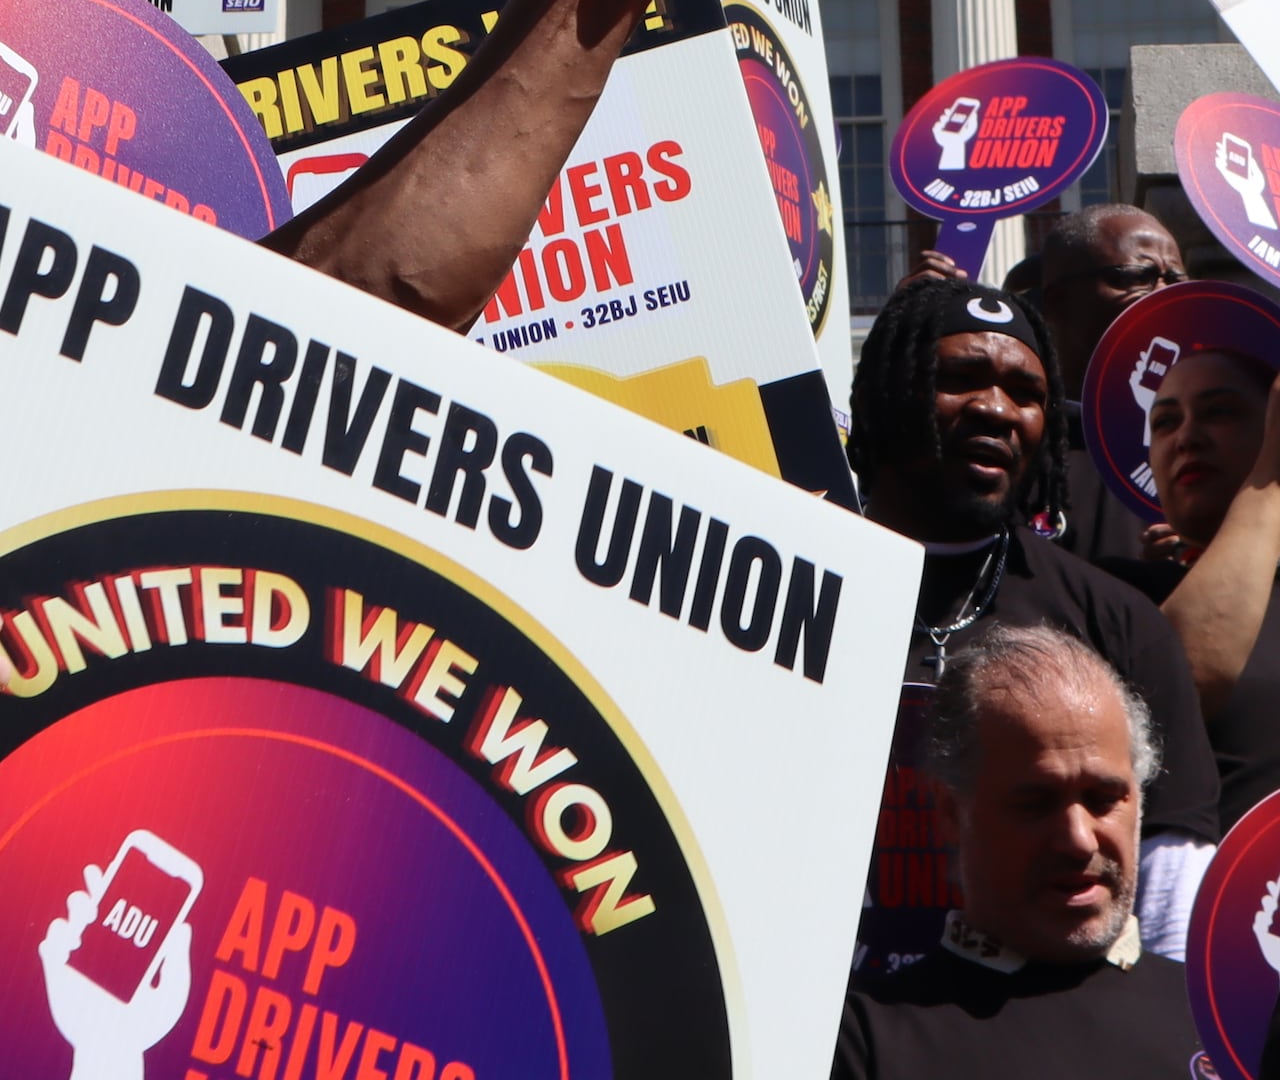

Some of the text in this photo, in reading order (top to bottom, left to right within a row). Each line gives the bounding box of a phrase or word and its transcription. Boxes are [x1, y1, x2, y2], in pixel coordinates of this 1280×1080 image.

[49, 75, 137, 157] APP
[776, 51, 808, 129] WON
[984, 96, 1028, 117] APP
[969, 139, 1059, 169] UNION
[978, 116, 1066, 139] DRIVERS
[923, 175, 1040, 208] IAM 32BJ SEIU
[493, 280, 691, 353] UNION 32BJ SEIU
[152, 284, 554, 551] DRIVERS
[572, 465, 844, 686] UNION
[334, 588, 479, 723] WE
[472, 685, 657, 938] WON
[878, 851, 965, 908] UNI
[104, 898, 159, 949] ADU
[214, 876, 357, 996] APP
[190, 969, 477, 1080] DRIVE
